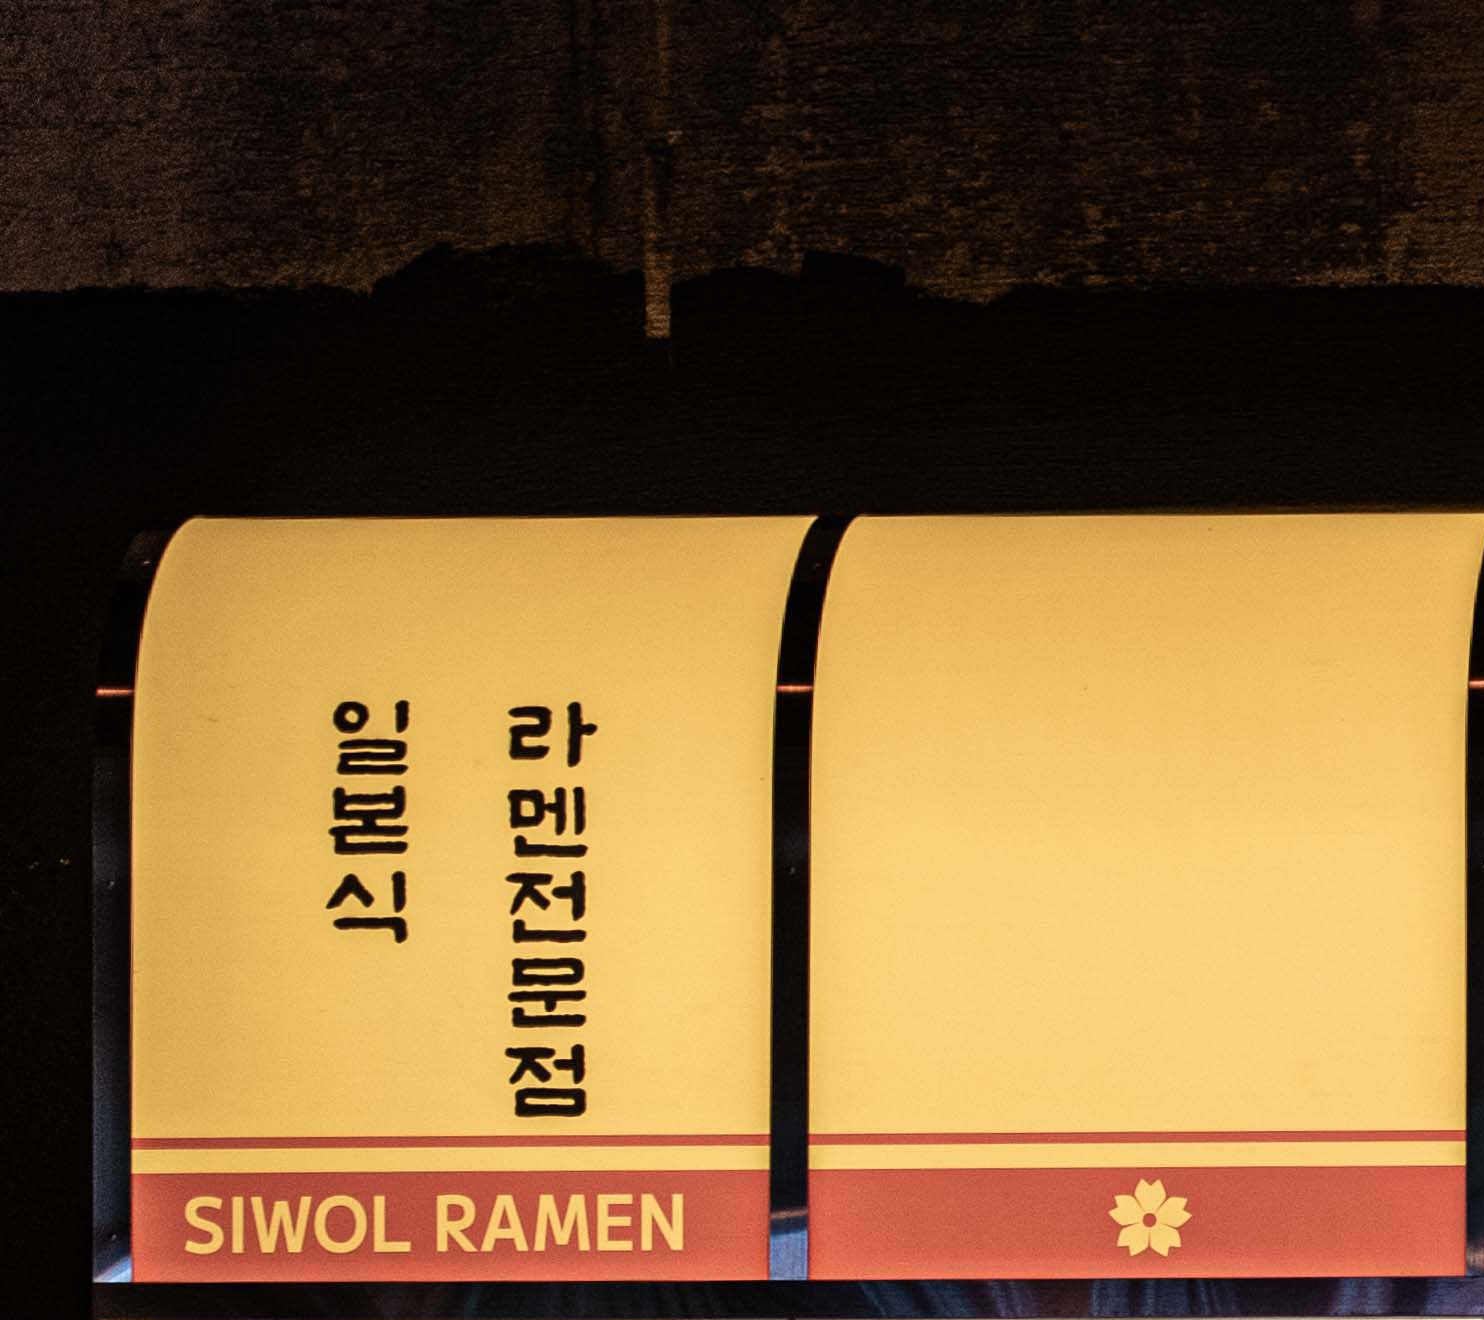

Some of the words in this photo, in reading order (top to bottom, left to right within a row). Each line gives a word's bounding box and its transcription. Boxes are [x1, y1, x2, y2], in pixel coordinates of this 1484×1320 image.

[326, 699, 408, 944] 일본식
[504, 700, 597, 1119] 라멘전문점
[183, 1195, 411, 1256] SIWOL
[436, 1192, 686, 1252] RAMEN
